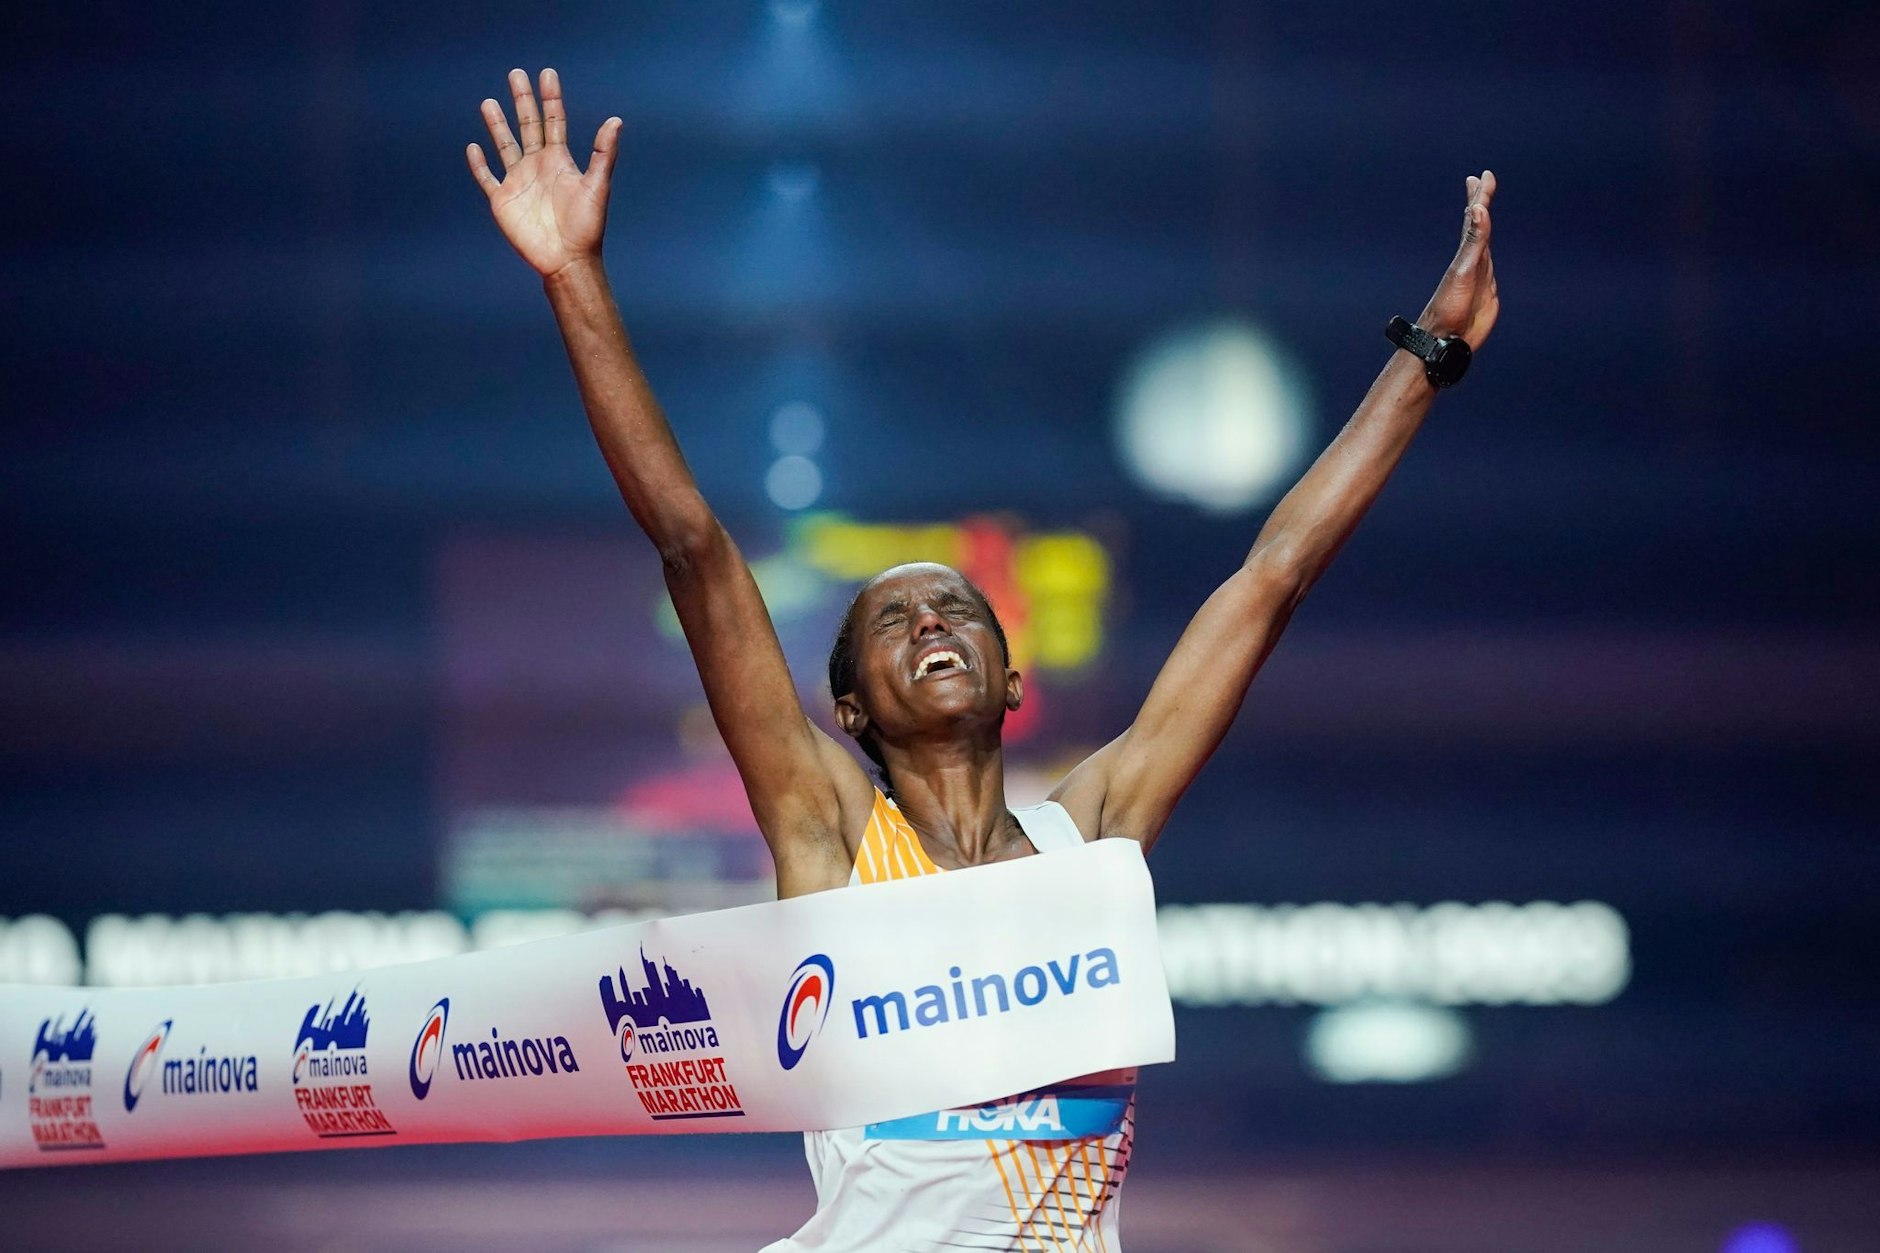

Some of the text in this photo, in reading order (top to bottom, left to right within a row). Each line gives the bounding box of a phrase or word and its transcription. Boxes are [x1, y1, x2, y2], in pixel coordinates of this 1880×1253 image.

[851, 946, 1121, 1039] mainova
[451, 1026, 580, 1081] mainova
[638, 1023, 720, 1054] mainova
[162, 1044, 259, 1095] mainova
[308, 1050, 368, 1078] mainova
[626, 1057, 727, 1089] FRANKFURT
[294, 1084, 376, 1110] FRANKFURT
[637, 1084, 742, 1114] MARATHON
[936, 1094, 1061, 1131] HOKA
[303, 1109, 392, 1135] MARATHON
